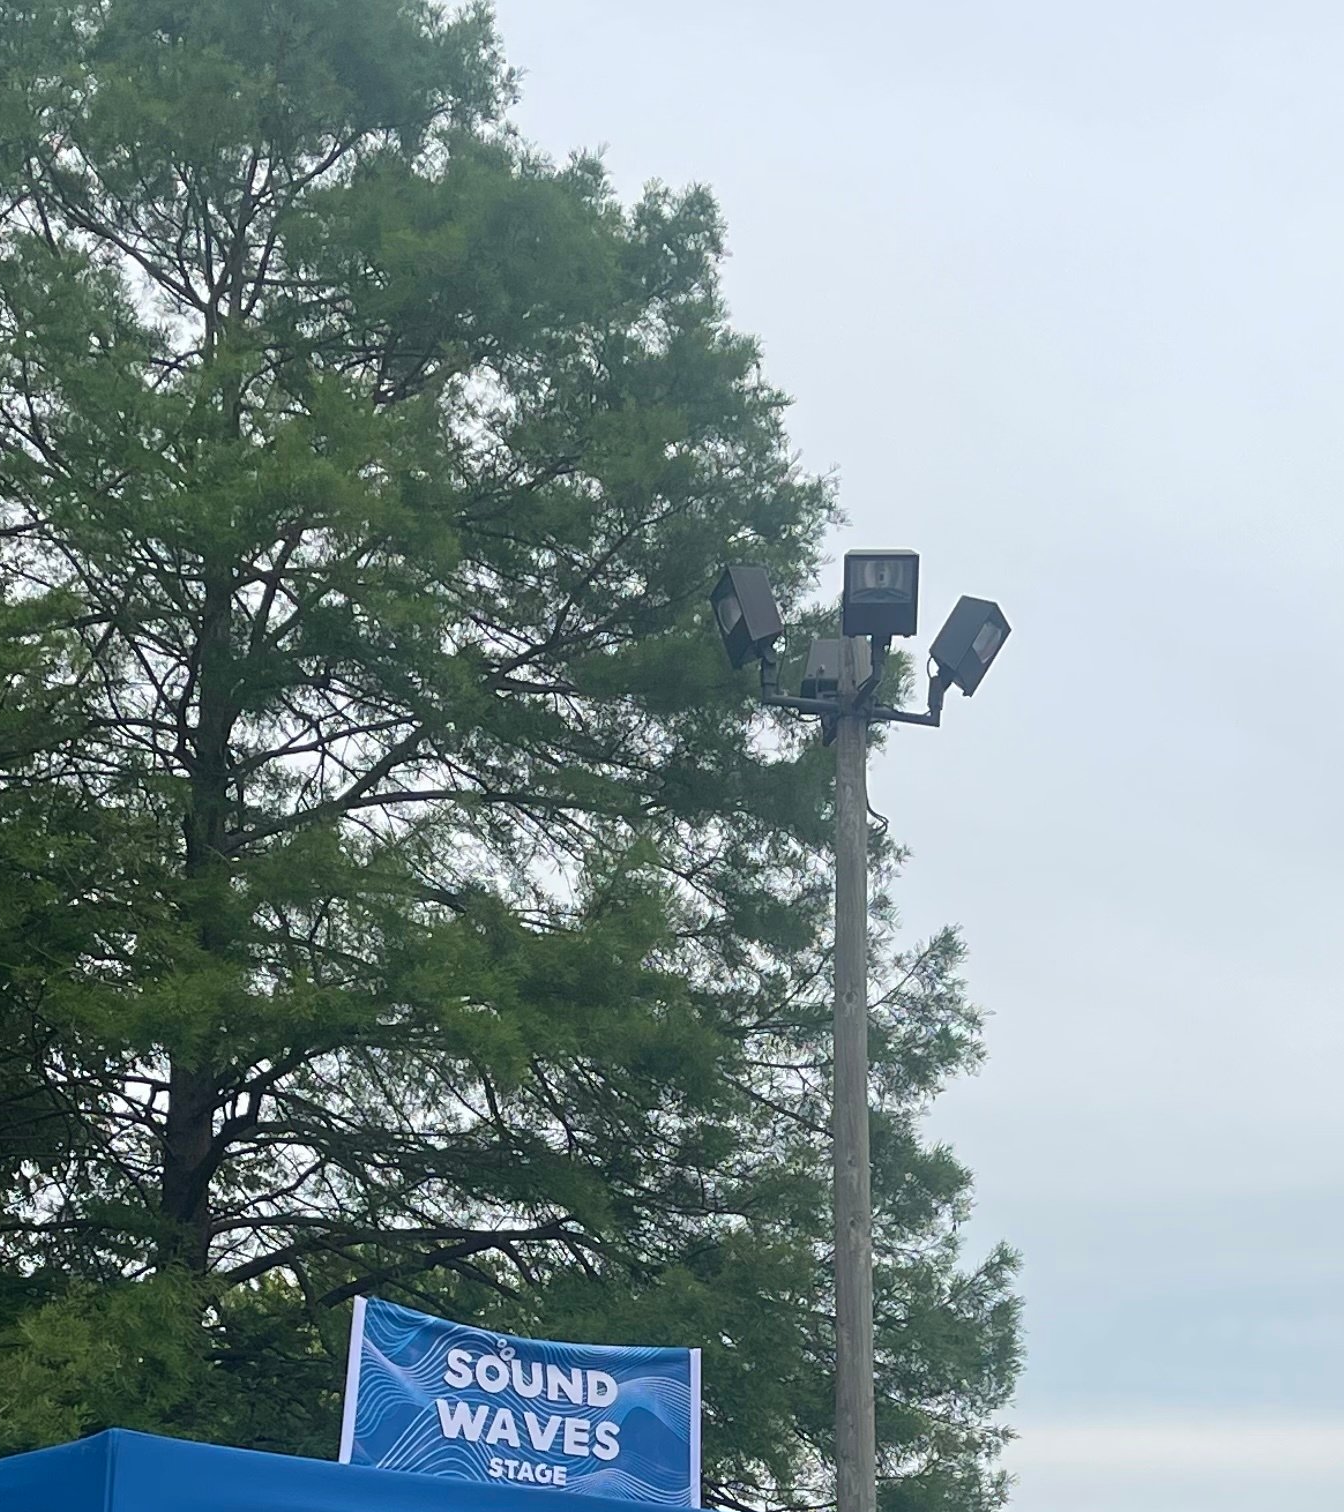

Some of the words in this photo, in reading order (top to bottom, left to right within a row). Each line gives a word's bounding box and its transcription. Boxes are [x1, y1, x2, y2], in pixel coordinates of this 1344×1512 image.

[443, 1348, 619, 1409] SOUND
[436, 1398, 621, 1462] WAVES
[489, 1457, 568, 1487] STAGE
